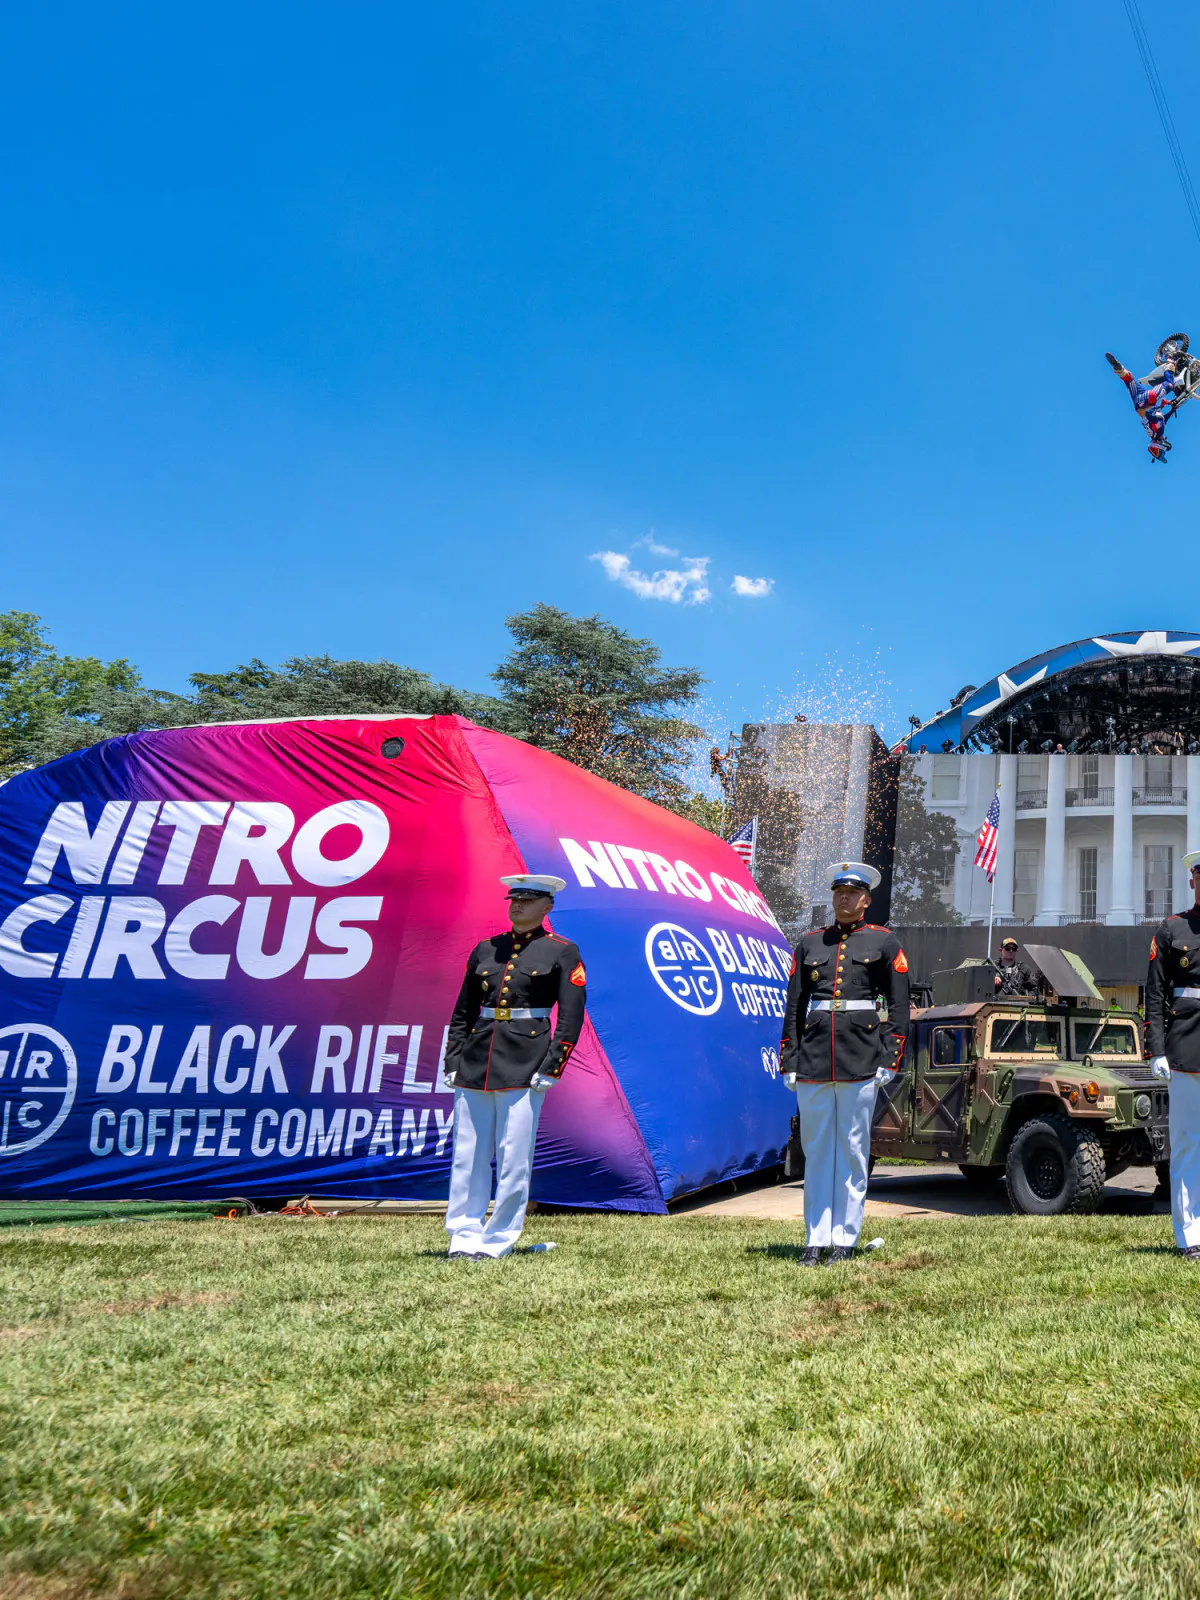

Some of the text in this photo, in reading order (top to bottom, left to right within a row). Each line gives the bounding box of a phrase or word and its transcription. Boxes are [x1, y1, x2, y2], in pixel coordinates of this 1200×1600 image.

[24, 799, 390, 887] NITRO
[559, 838, 713, 902] NITRO
[0, 894, 384, 980] CIRCUS
[706, 927, 784, 982] BLACK
[732, 982, 785, 1018] COFFEE
[95, 1025, 298, 1094] BLACK
[89, 1108, 455, 1157] COFFEE COMPANY
